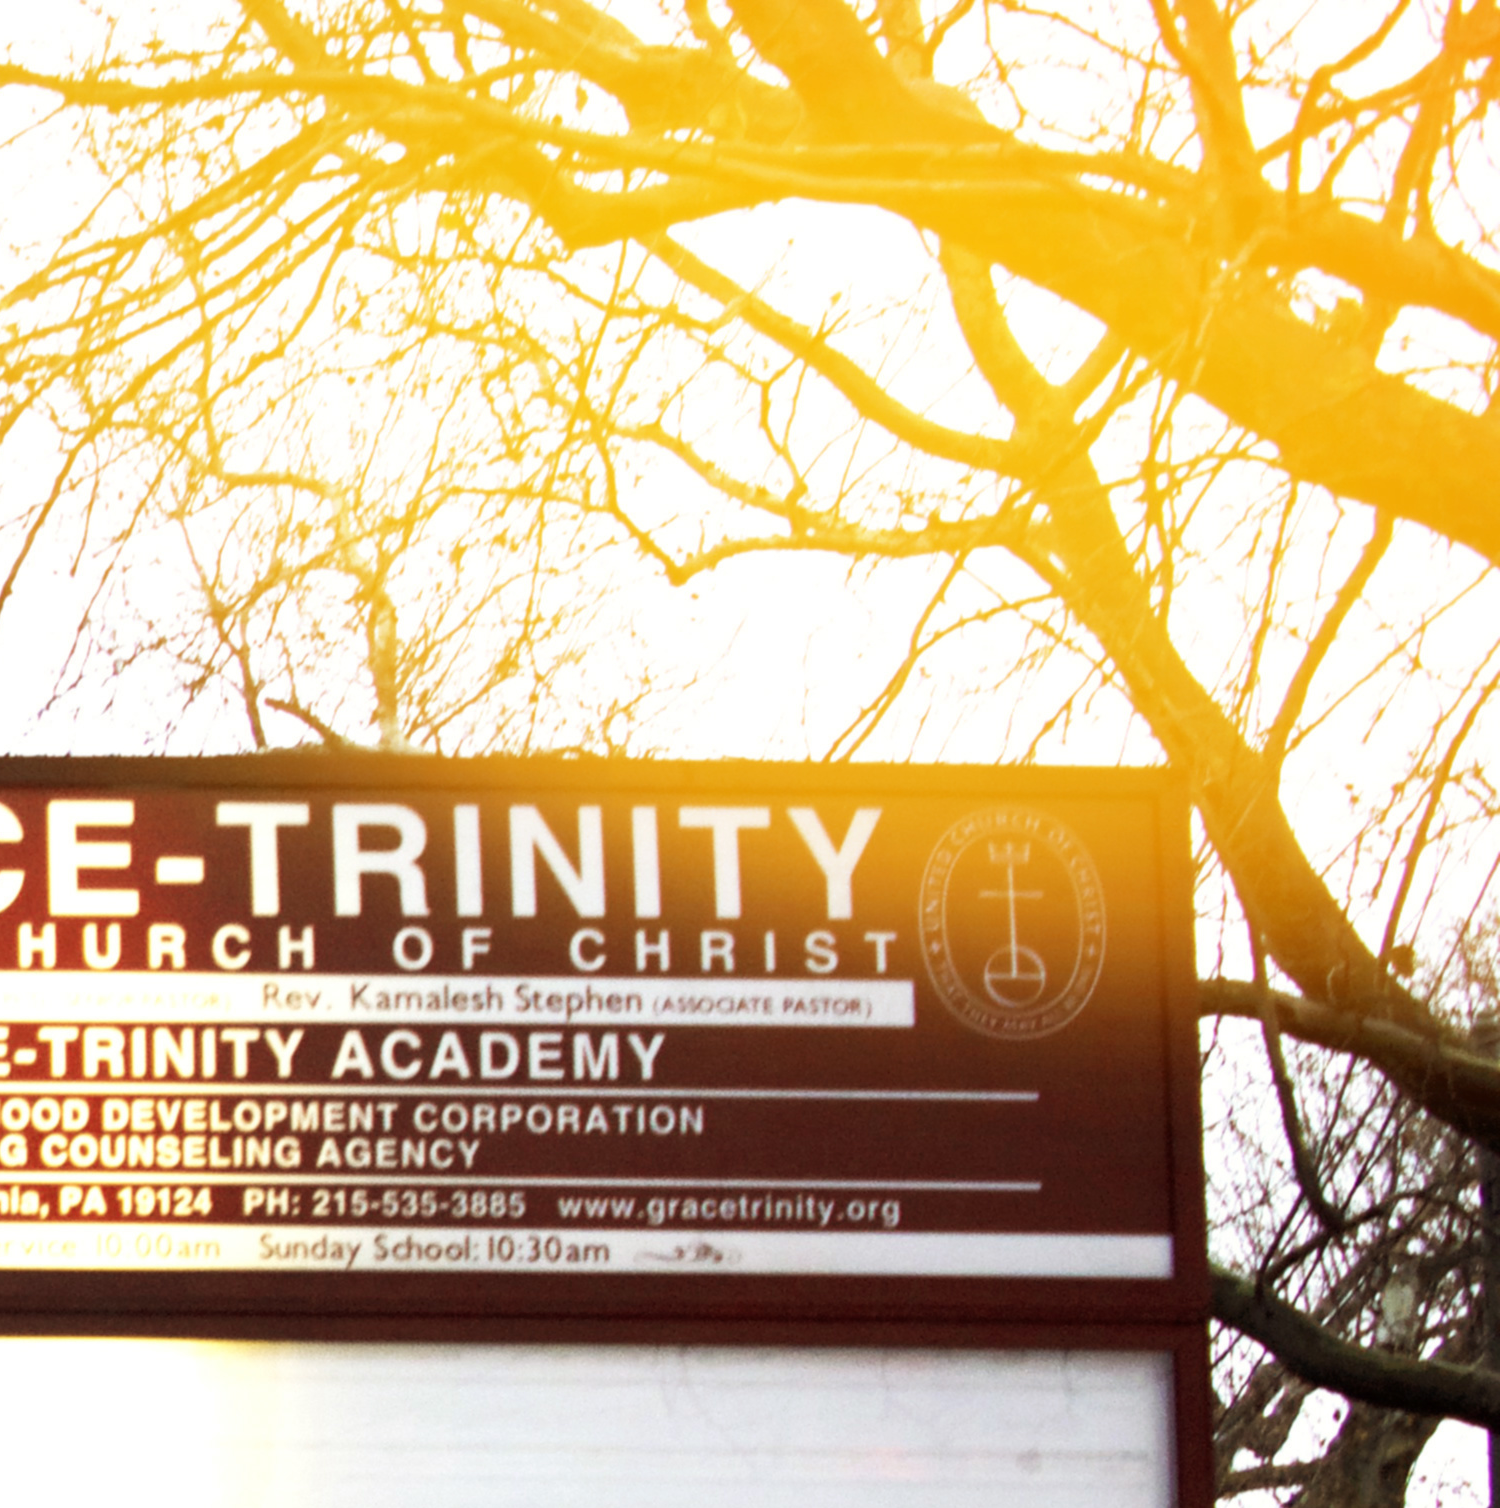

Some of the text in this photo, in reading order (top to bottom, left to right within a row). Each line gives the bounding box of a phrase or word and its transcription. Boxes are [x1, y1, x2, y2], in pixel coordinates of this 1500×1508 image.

[392, 926, 493, 971] OF
[569, 928, 898, 975] CHRIST
[349, 983, 504, 1012] Kamalesh
[514, 984, 644, 1022] Stephen
[331, 1030, 665, 1081] ACADEMY
[102, 1099, 398, 1133] DEVELOPMENT
[412, 1102, 704, 1135] CORPORATION
[40, 1135, 302, 1168] COUNSELING
[316, 1137, 480, 1169] AGENCY
[59, 1186, 108, 1215] PA
[117, 1186, 213, 1216] 19124
[244, 1188, 299, 1216] PH:
[311, 1189, 527, 1219] 215-535-3885
[557, 1190, 901, 1228] www.gracetrinity.org
[258, 1233, 362, 1271] Sunday
